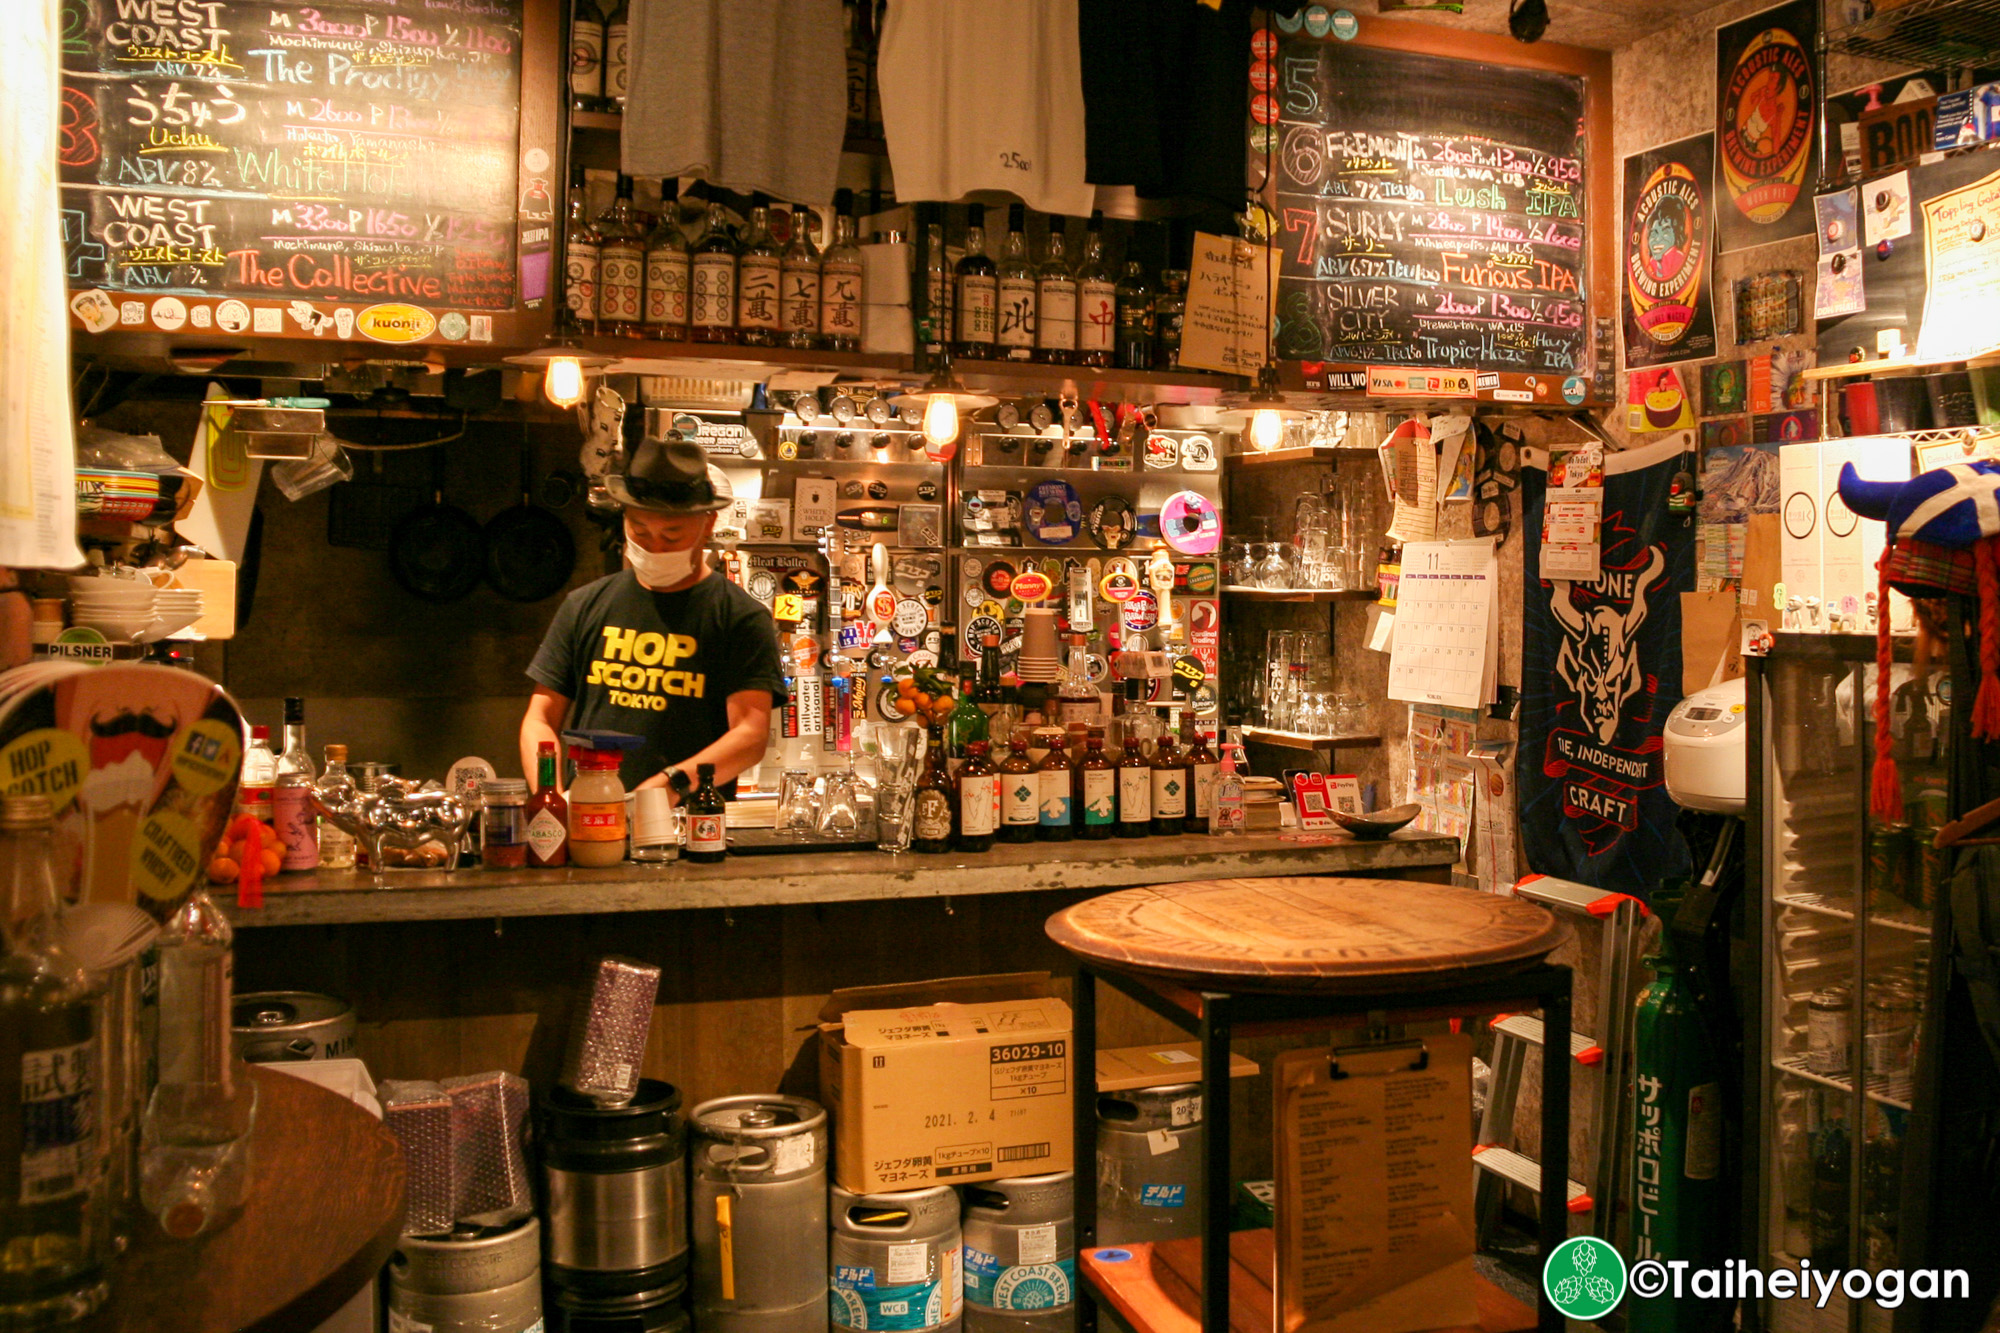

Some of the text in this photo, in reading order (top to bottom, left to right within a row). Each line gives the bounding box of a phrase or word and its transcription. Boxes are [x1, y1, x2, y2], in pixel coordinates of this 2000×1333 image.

[116, 0, 227, 28] WEST
[270, 11, 292, 27] M
[364, 14, 379, 36] P
[106, 21, 231, 50] COAST
[248, 49, 313, 85] The
[328, 53, 448, 101] Prodigy
[1732, 47, 1806, 97] ACOUSTIC ALES
[1284, 57, 1320, 116] 5
[127, 82, 247, 127] うちゅう
[286, 102, 304, 117] M
[370, 104, 384, 125] P
[150, 126, 213, 147] Uchu
[1326, 131, 1420, 170] FREMONT
[1725, 110, 1810, 177] BREWING EXPERIMENT
[1282, 126, 1321, 185] 6
[234, 147, 338, 193] White
[107, 195, 210, 224] WEST
[1435, 178, 1507, 211] Lush
[1525, 190, 1578, 218] IPA
[1637, 180, 1699, 223] ACOUSTIC ALES
[271, 208, 293, 225] M
[349, 210, 364, 233] P
[1326, 207, 1405, 242] SURLY
[1471, 214, 1482, 232] P
[103, 221, 216, 250] COAST
[535, 228, 550, 242] IPA
[1283, 207, 1320, 265] 7
[228, 250, 285, 288] The
[287, 253, 441, 297] Collective
[1317, 255, 1349, 276] ABV
[1441, 251, 1578, 294] Furious IPA
[1630, 239, 1701, 298] BREWING EXPERIMENT
[1327, 284, 1400, 311] SILVER
[1416, 292, 1428, 307] M
[373, 316, 420, 332] kuonji
[1001, 296, 1034, 335] 北
[1088, 300, 1114, 345] 中
[1340, 309, 1390, 331] CITY
[1543, 350, 1575, 369] IPA
[1328, 373, 1351, 388] WILL
[1352, 373, 1367, 387] WO
[1373, 378, 1393, 388] VISA
[805, 514, 824, 522] HOLE
[1428, 553, 1439, 571] 11
[1576, 572, 1634, 600] ONE
[49, 645, 112, 658] PILSNER
[602, 625, 698, 668] HOP
[1192, 637, 1216, 645] Trading
[586, 660, 706, 699] SCOTCH
[608, 690, 668, 712] TOKYO
[800, 679, 811, 732] stillwater
[810, 680, 822, 732] artisanal
[9, 740, 51, 778] HOP
[1568, 785, 1628, 824] CRAFT
[528, 829, 563, 838] ABASCO
[991, 1043, 1064, 1062] 36029-10
[924, 1114, 958, 1129] 2021.
[989, 1108, 996, 1121] 4
[874, 1155, 933, 1172] ジェフダ卵黄
[878, 1169, 929, 1183] マヨネーズ
[1636, 1074, 1662, 1260] サッポロビール
[1145, 1185, 1183, 1199] チルド
[964, 1248, 996, 1266] チルド
[838, 1268, 871, 1282] チルド
[1010, 1266, 1049, 1284] COAST
[883, 1303, 907, 1313] WCB
